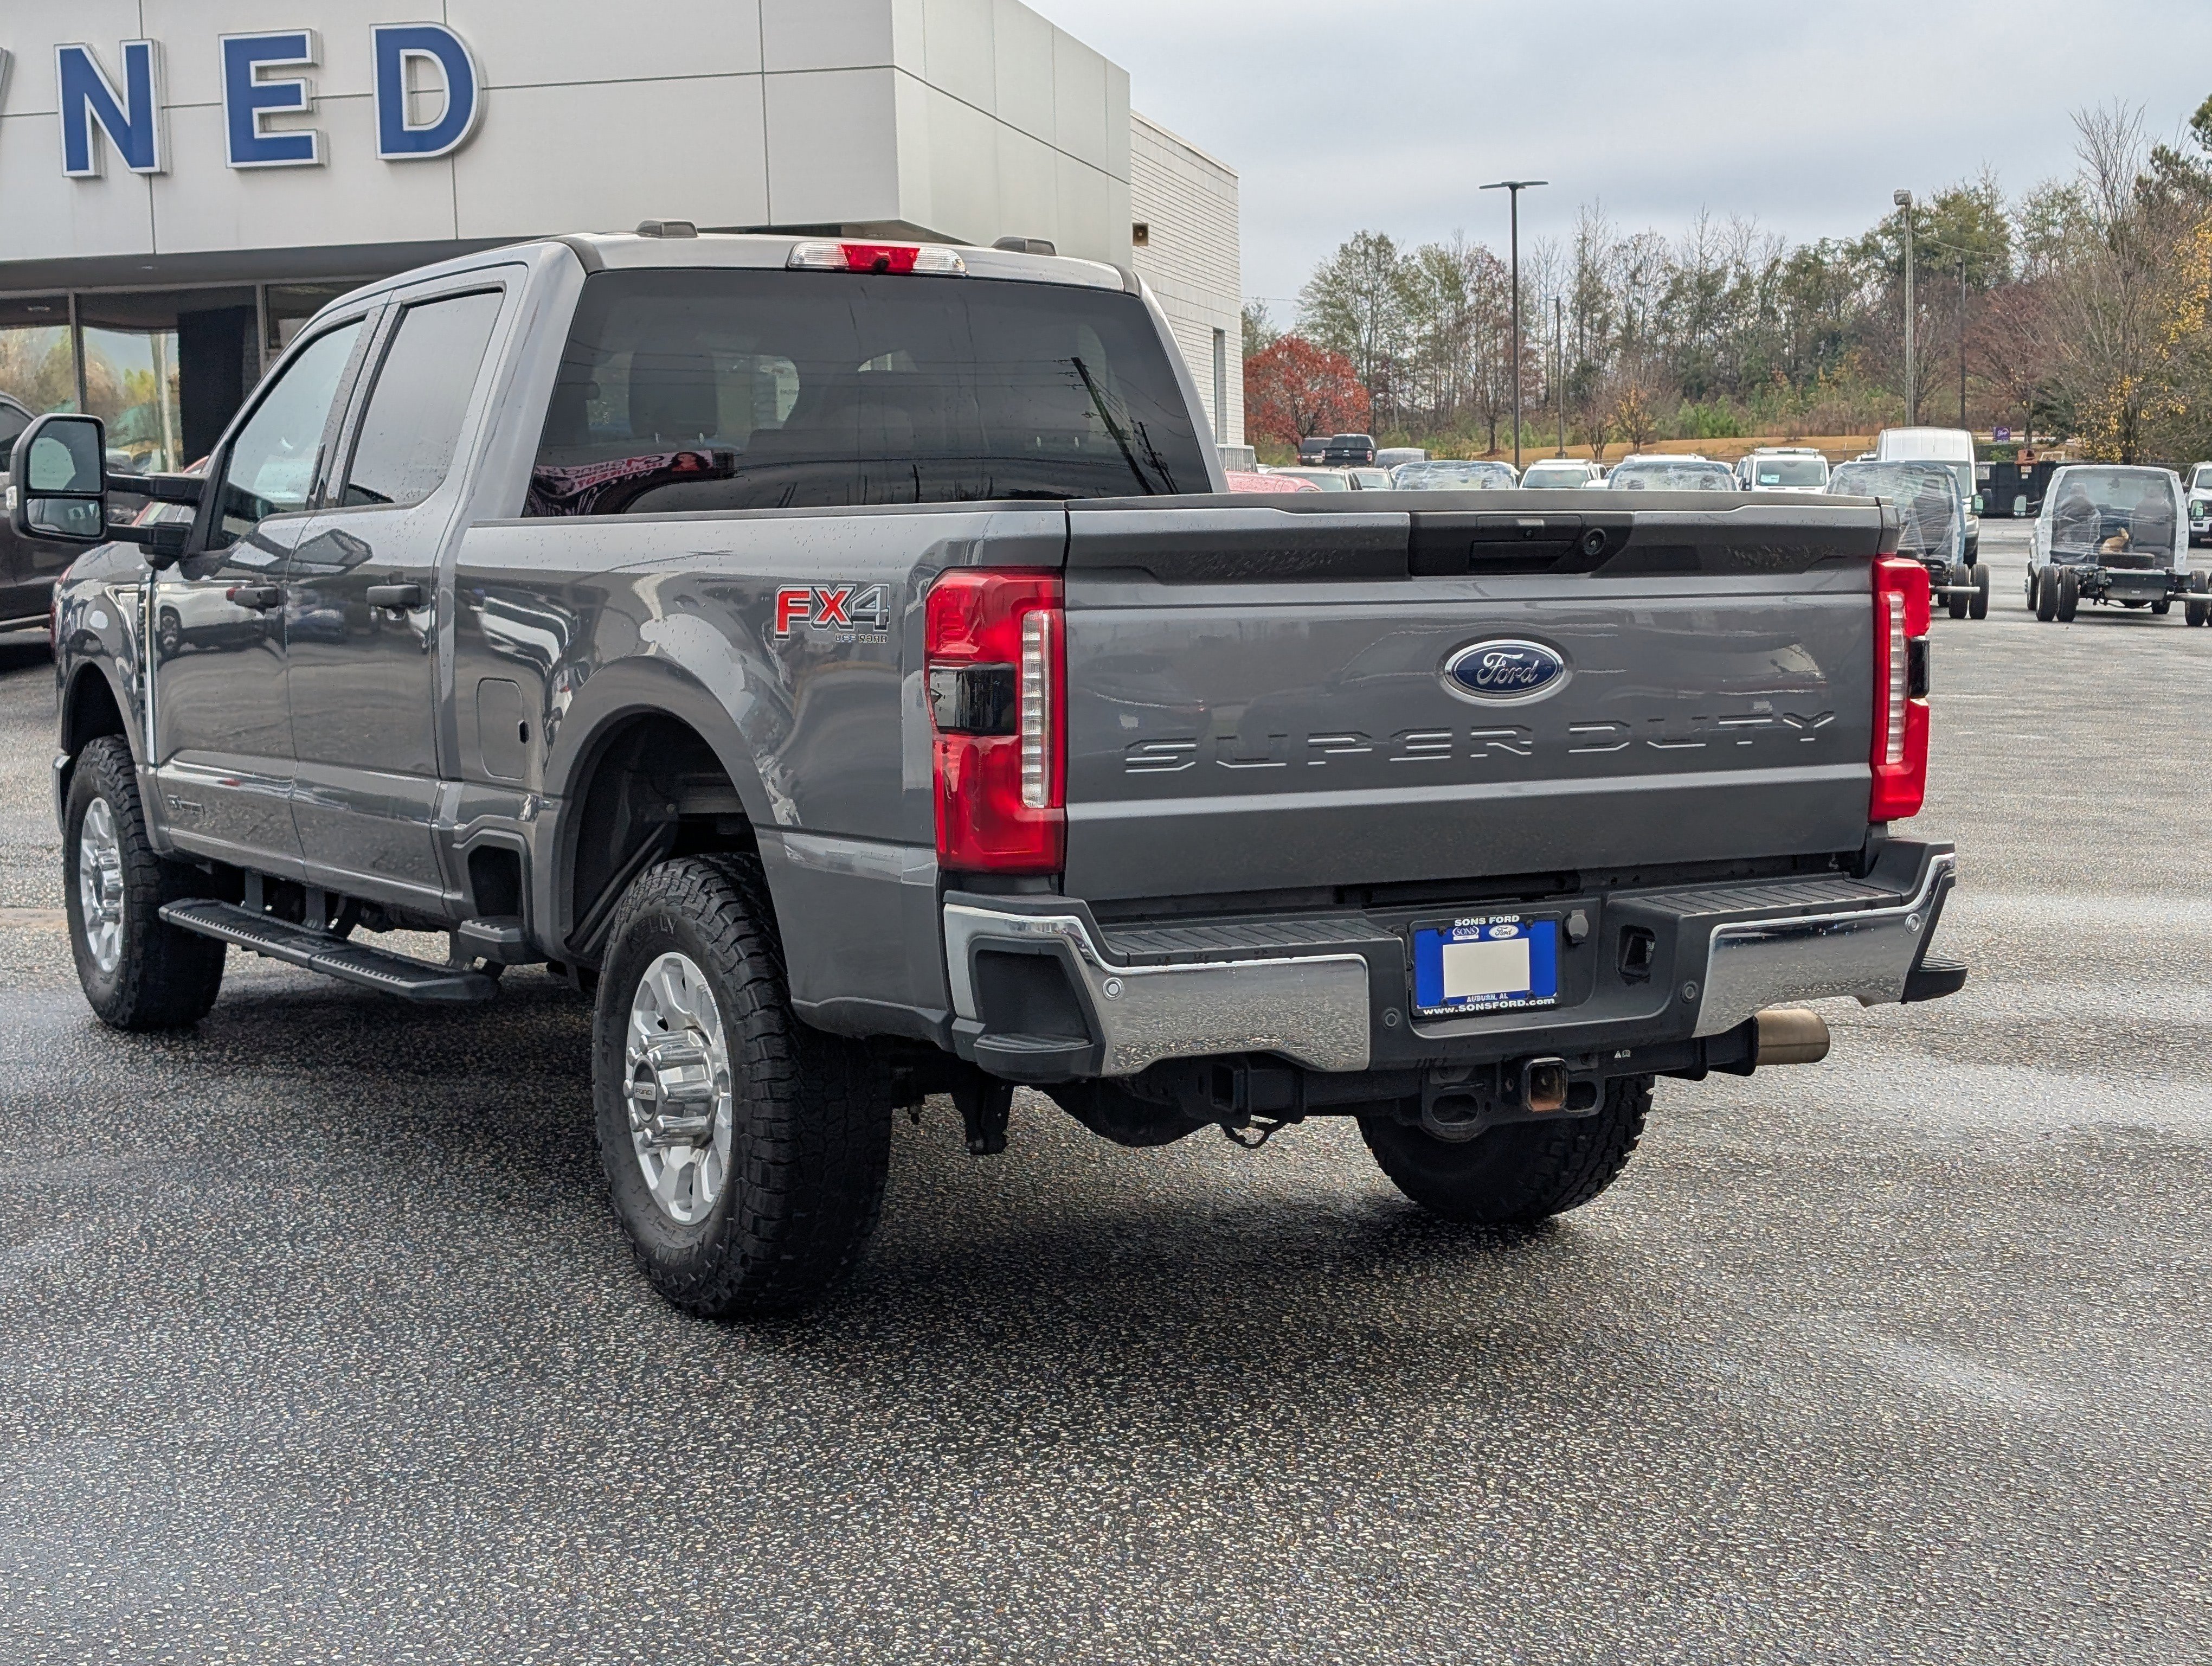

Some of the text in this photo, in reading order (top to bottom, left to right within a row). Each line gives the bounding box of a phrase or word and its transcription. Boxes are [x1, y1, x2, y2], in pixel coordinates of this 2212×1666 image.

[0, 21, 486, 178] NED
[774, 584, 890, 640] FX4
[1476, 652, 1540, 685] Ford
[1125, 710, 1835, 773] SUPER DUTY
[1454, 914, 1520, 927] SONS FORD
[1494, 926, 1513, 937] Ford
[1423, 997, 1555, 1015] www.SONSFORD.com
